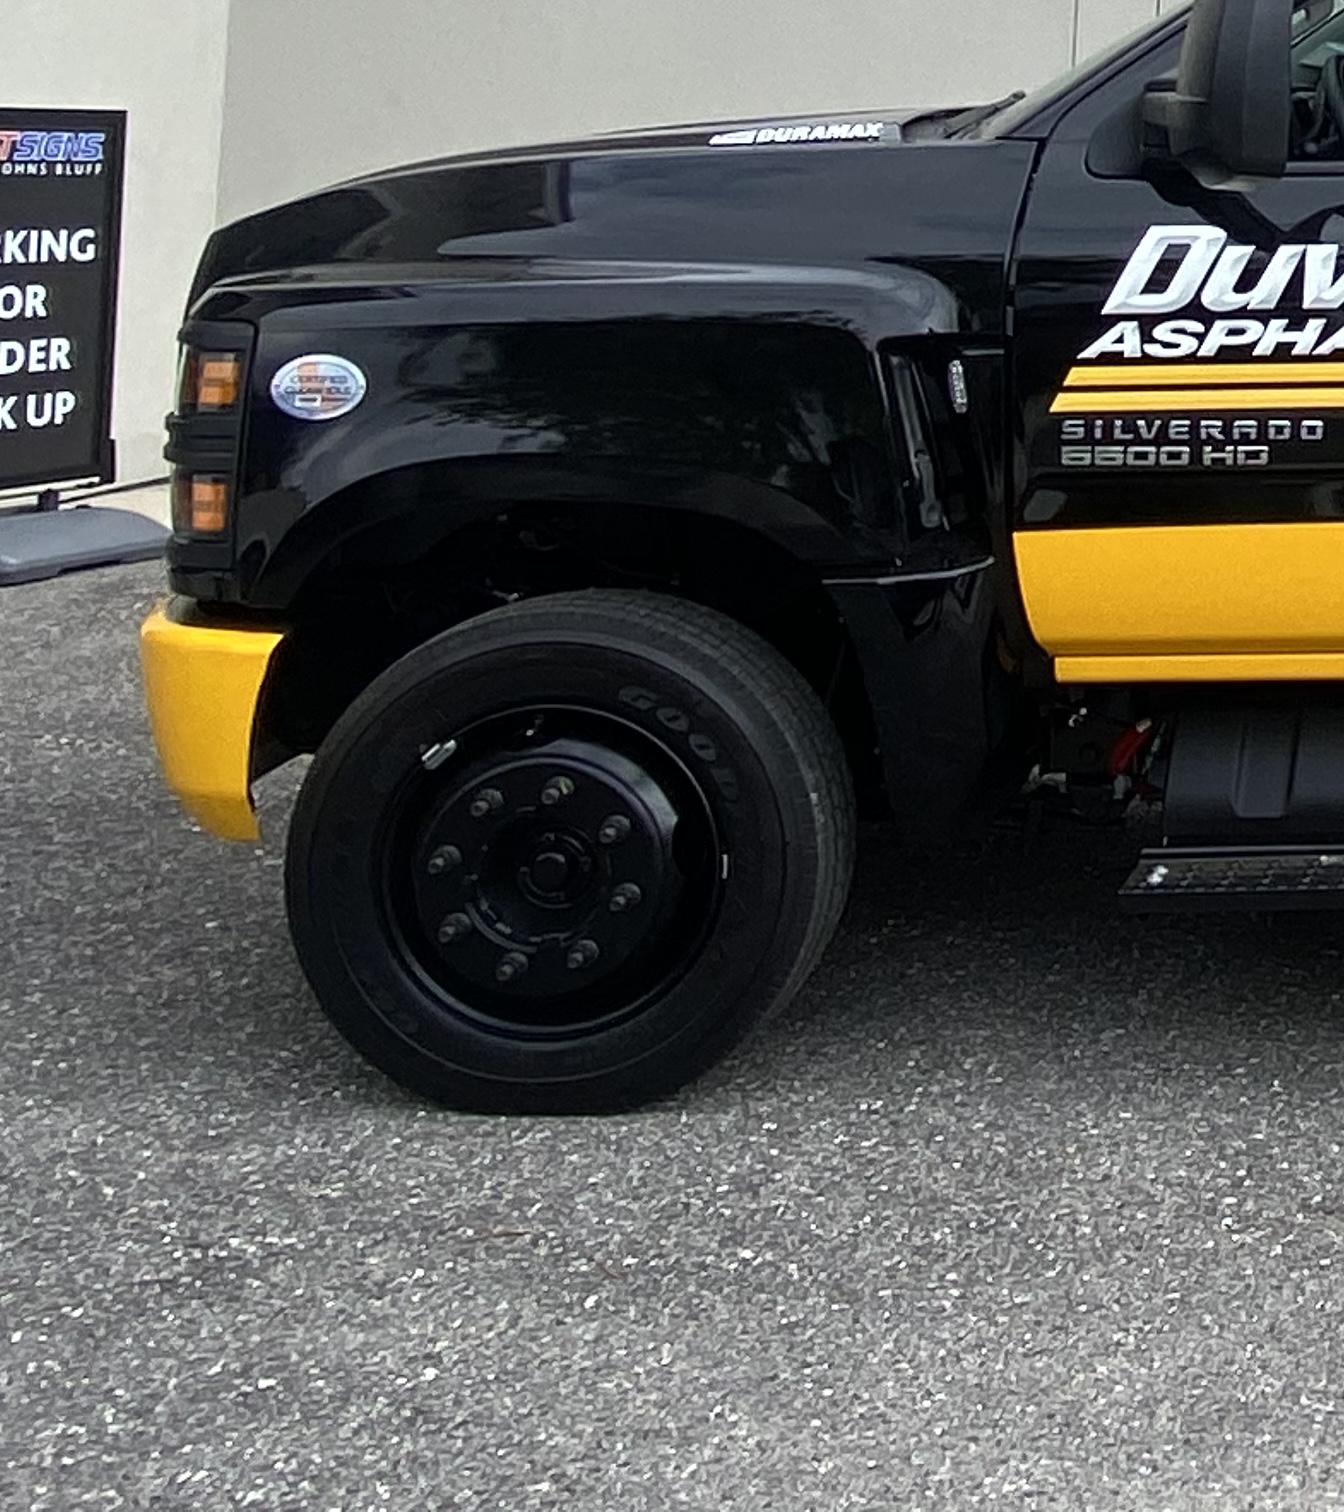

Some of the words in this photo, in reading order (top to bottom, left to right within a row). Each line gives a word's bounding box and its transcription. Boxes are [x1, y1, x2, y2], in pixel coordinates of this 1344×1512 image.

[756, 122, 884, 145] DURAMAX
[55, 162, 103, 176] BLUFF
[0, 228, 97, 264] KING
[0, 284, 47, 319] OR
[0, 338, 72, 375] DER
[26, 391, 76, 427] UP
[1060, 419, 1325, 440] SILVERADO
[1201, 445, 1270, 466] HD
